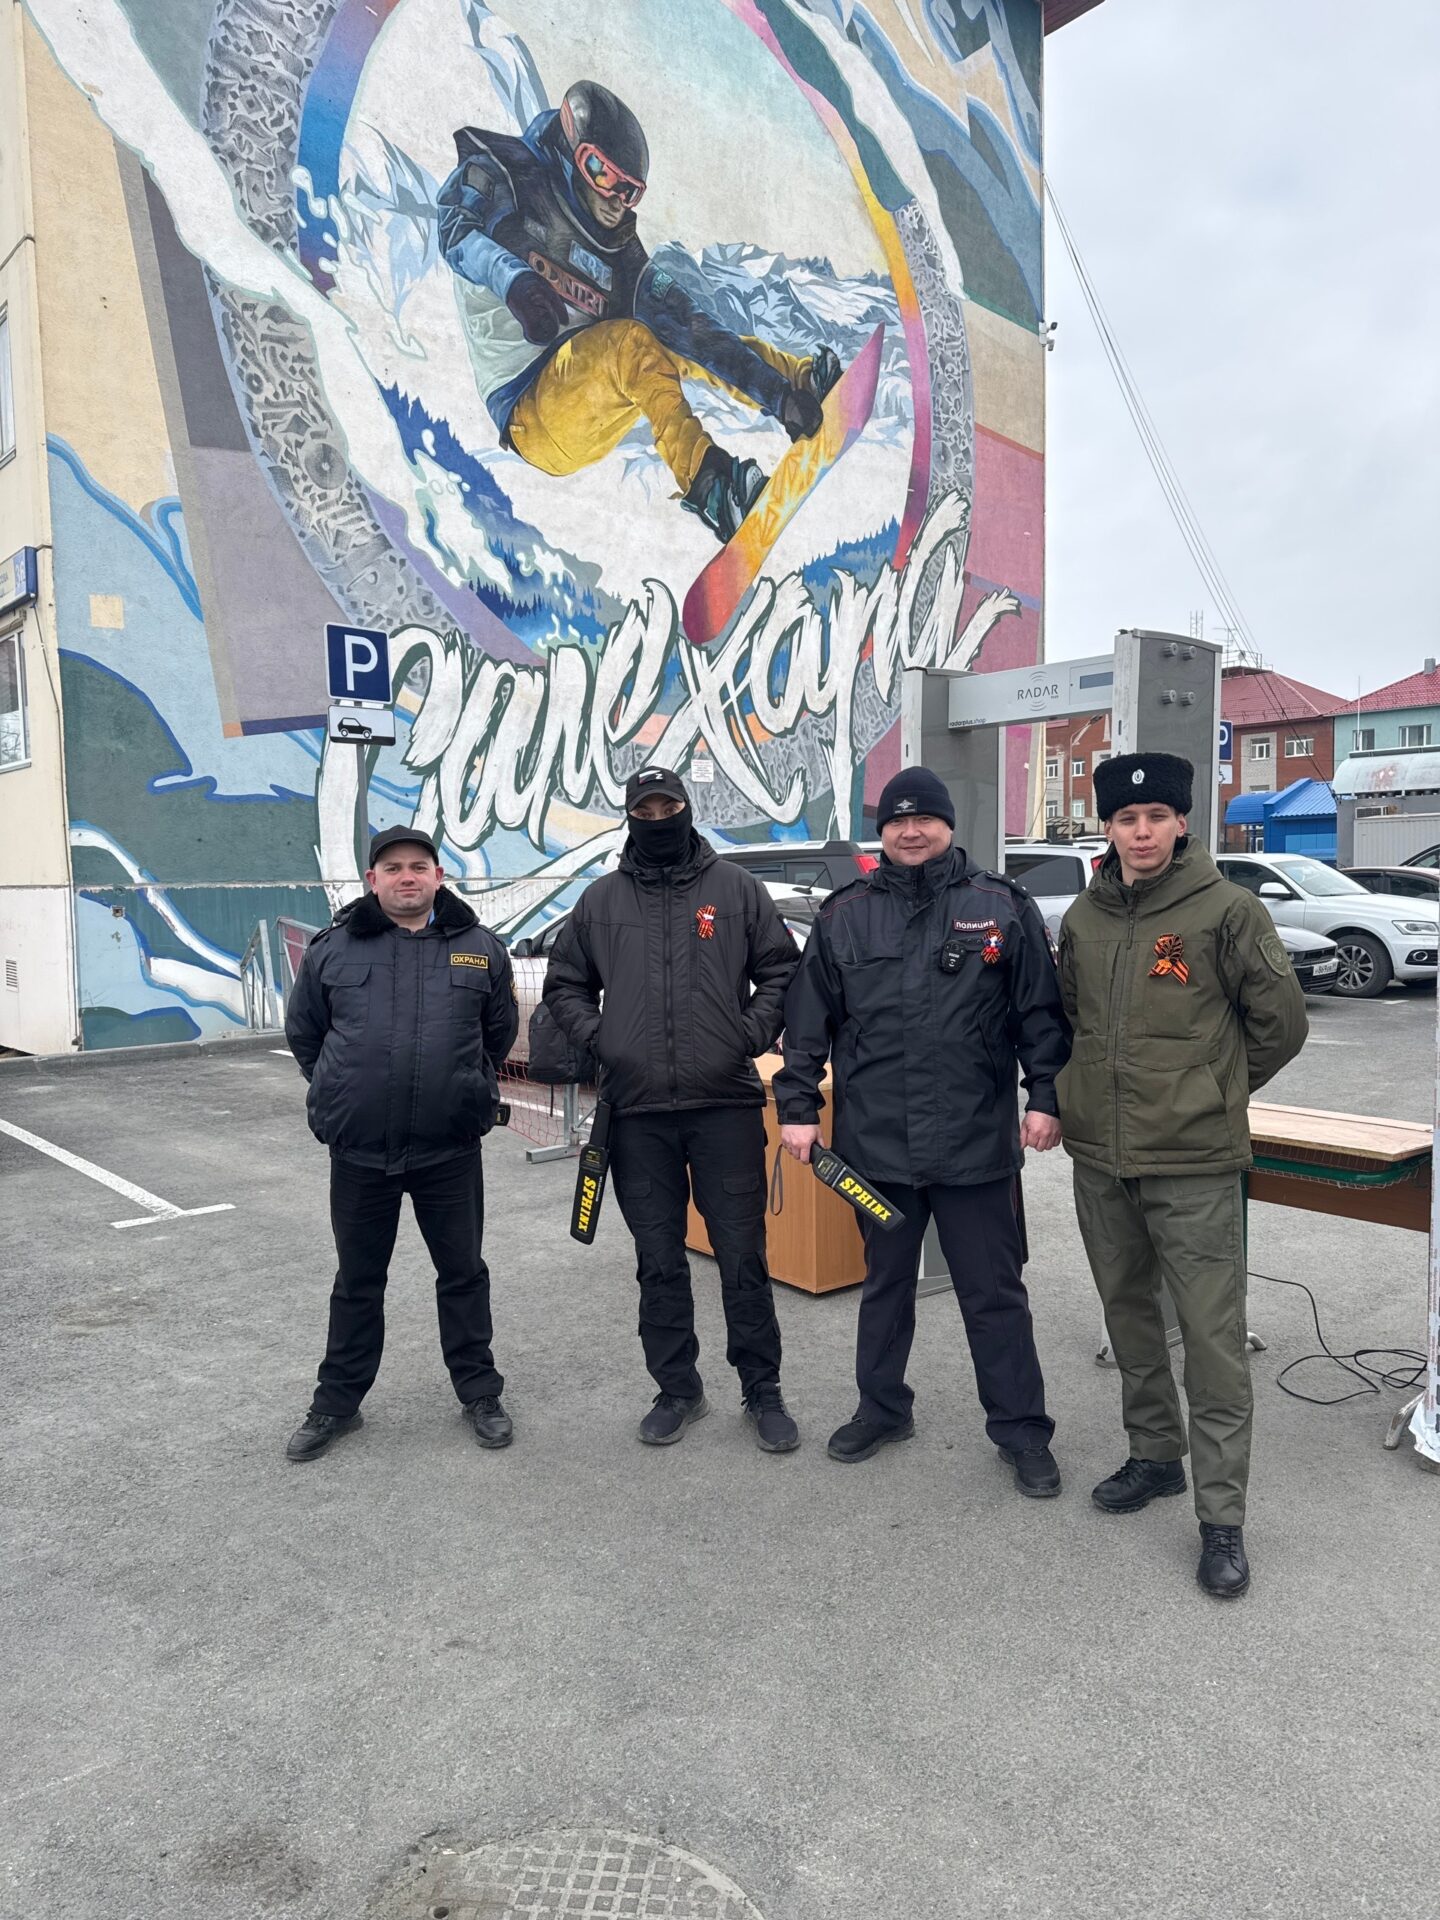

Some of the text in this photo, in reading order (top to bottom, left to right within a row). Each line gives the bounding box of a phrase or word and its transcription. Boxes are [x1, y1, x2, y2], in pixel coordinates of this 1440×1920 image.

[344, 634, 378, 692] P
[1017, 684, 1059, 701] RADAR
[949, 718, 986, 728] radarplus.shop
[956, 920, 995, 930] ПОЛИЦИЯ
[453, 955, 486, 966] ОХРАНА
[578, 1175, 597, 1233] SPHINX
[839, 1177, 892, 1221] SPHINX
